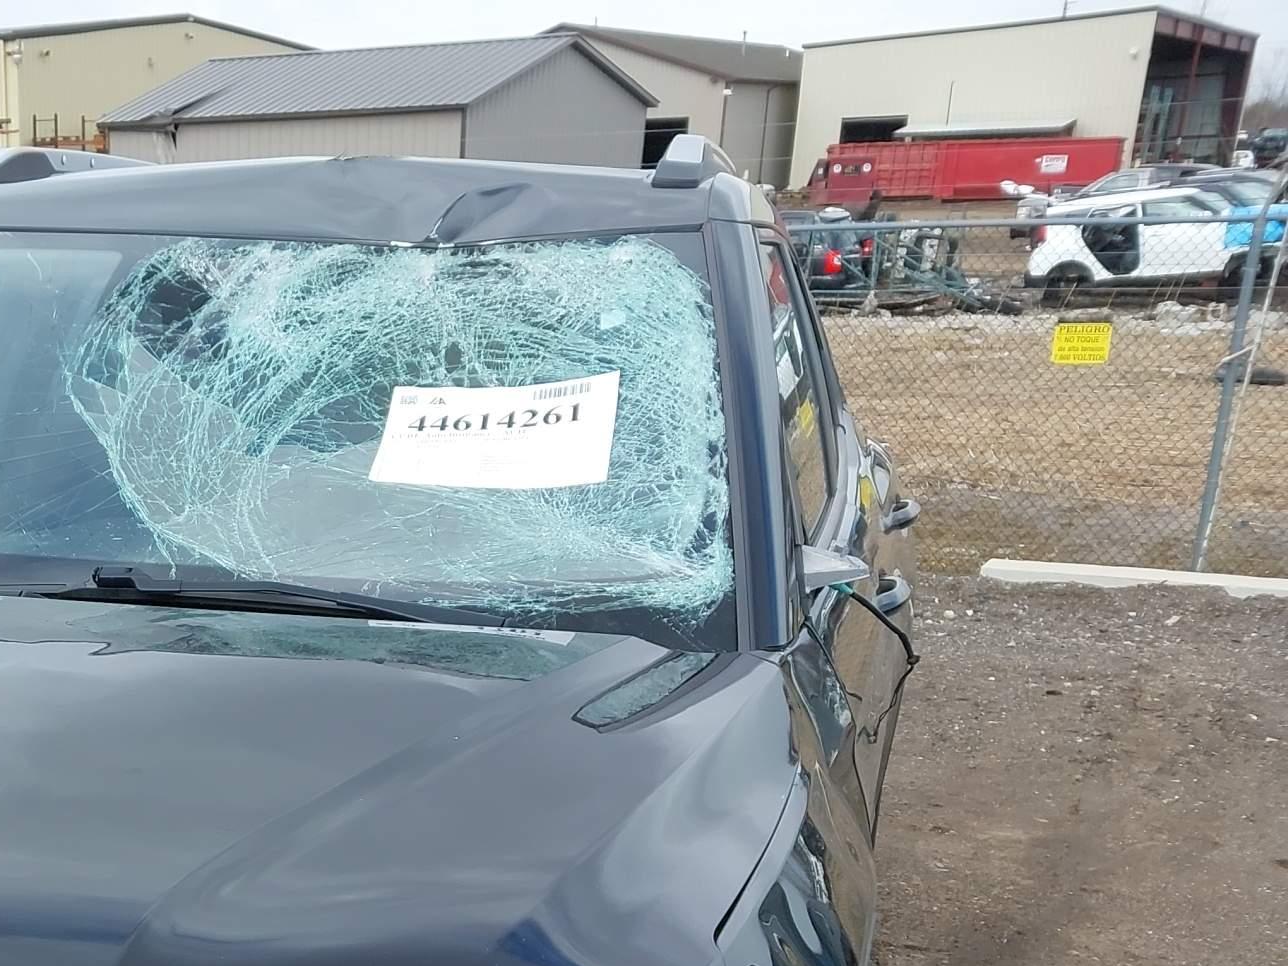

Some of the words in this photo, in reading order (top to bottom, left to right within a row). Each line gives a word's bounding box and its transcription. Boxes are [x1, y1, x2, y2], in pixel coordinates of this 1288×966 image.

[1059, 325, 1110, 333] PELIGRO
[1064, 335, 1075, 343] NO
[1077, 335, 1100, 343] TOQUE
[407, 402, 582, 432] 44614261
